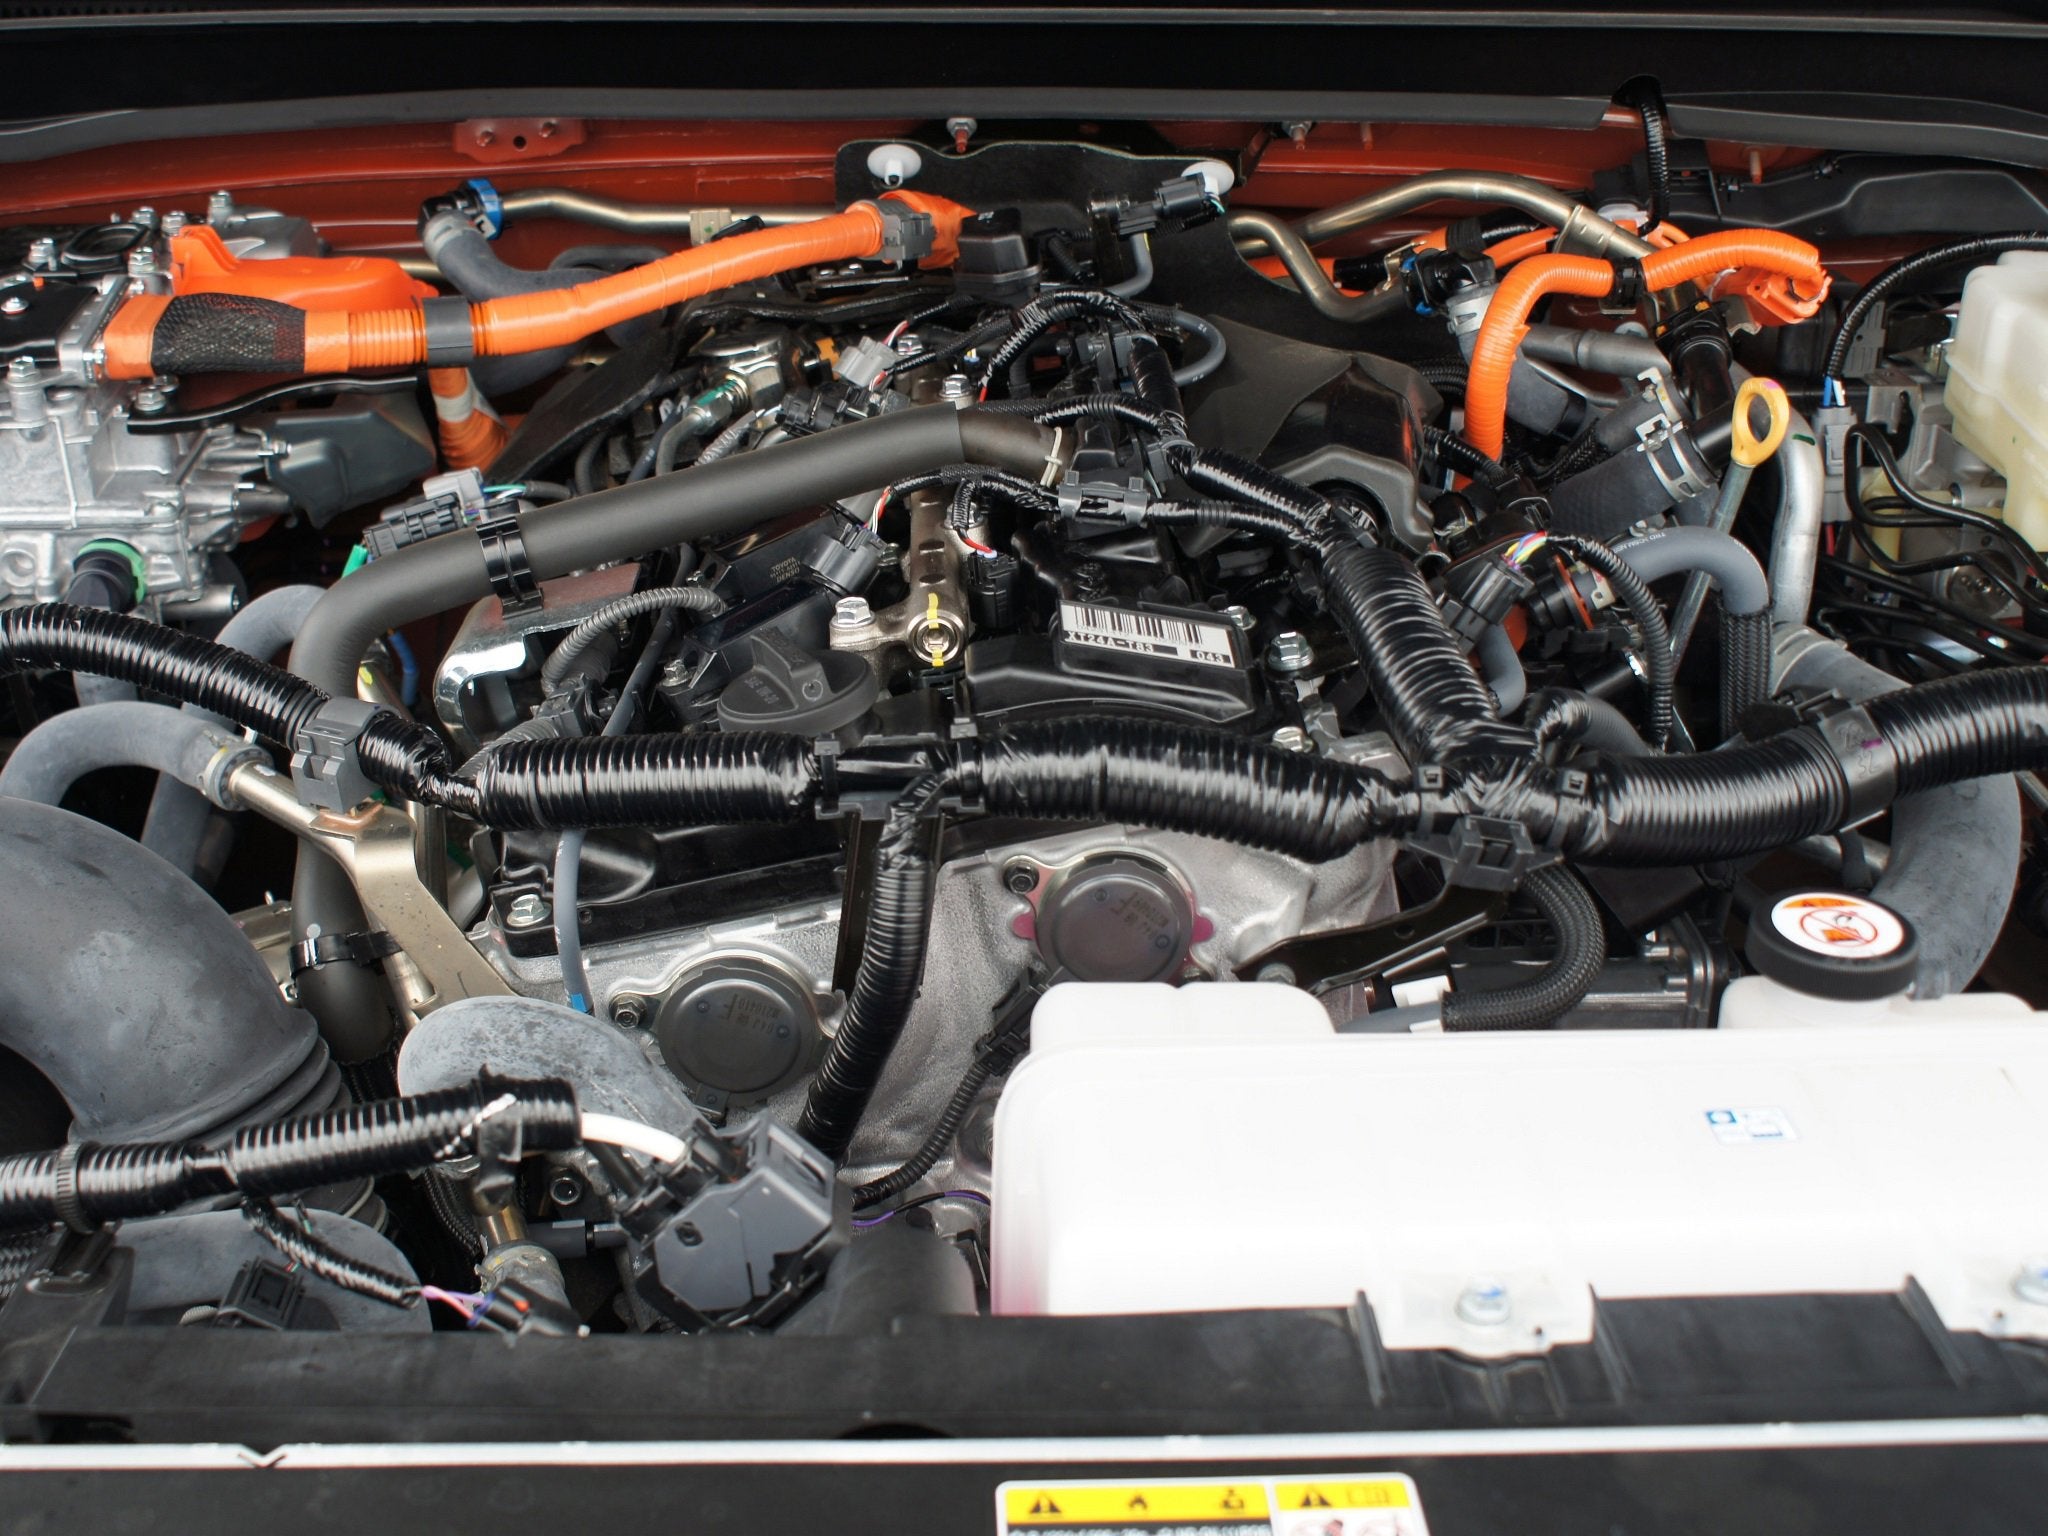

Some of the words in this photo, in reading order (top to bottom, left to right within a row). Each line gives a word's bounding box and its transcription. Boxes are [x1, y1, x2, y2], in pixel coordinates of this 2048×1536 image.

[771, 557, 796, 572] TOYOTA
[776, 567, 800, 582] DENSO
[1067, 631, 1154, 653] XT24A-T83
[1197, 651, 1224, 662] 043
